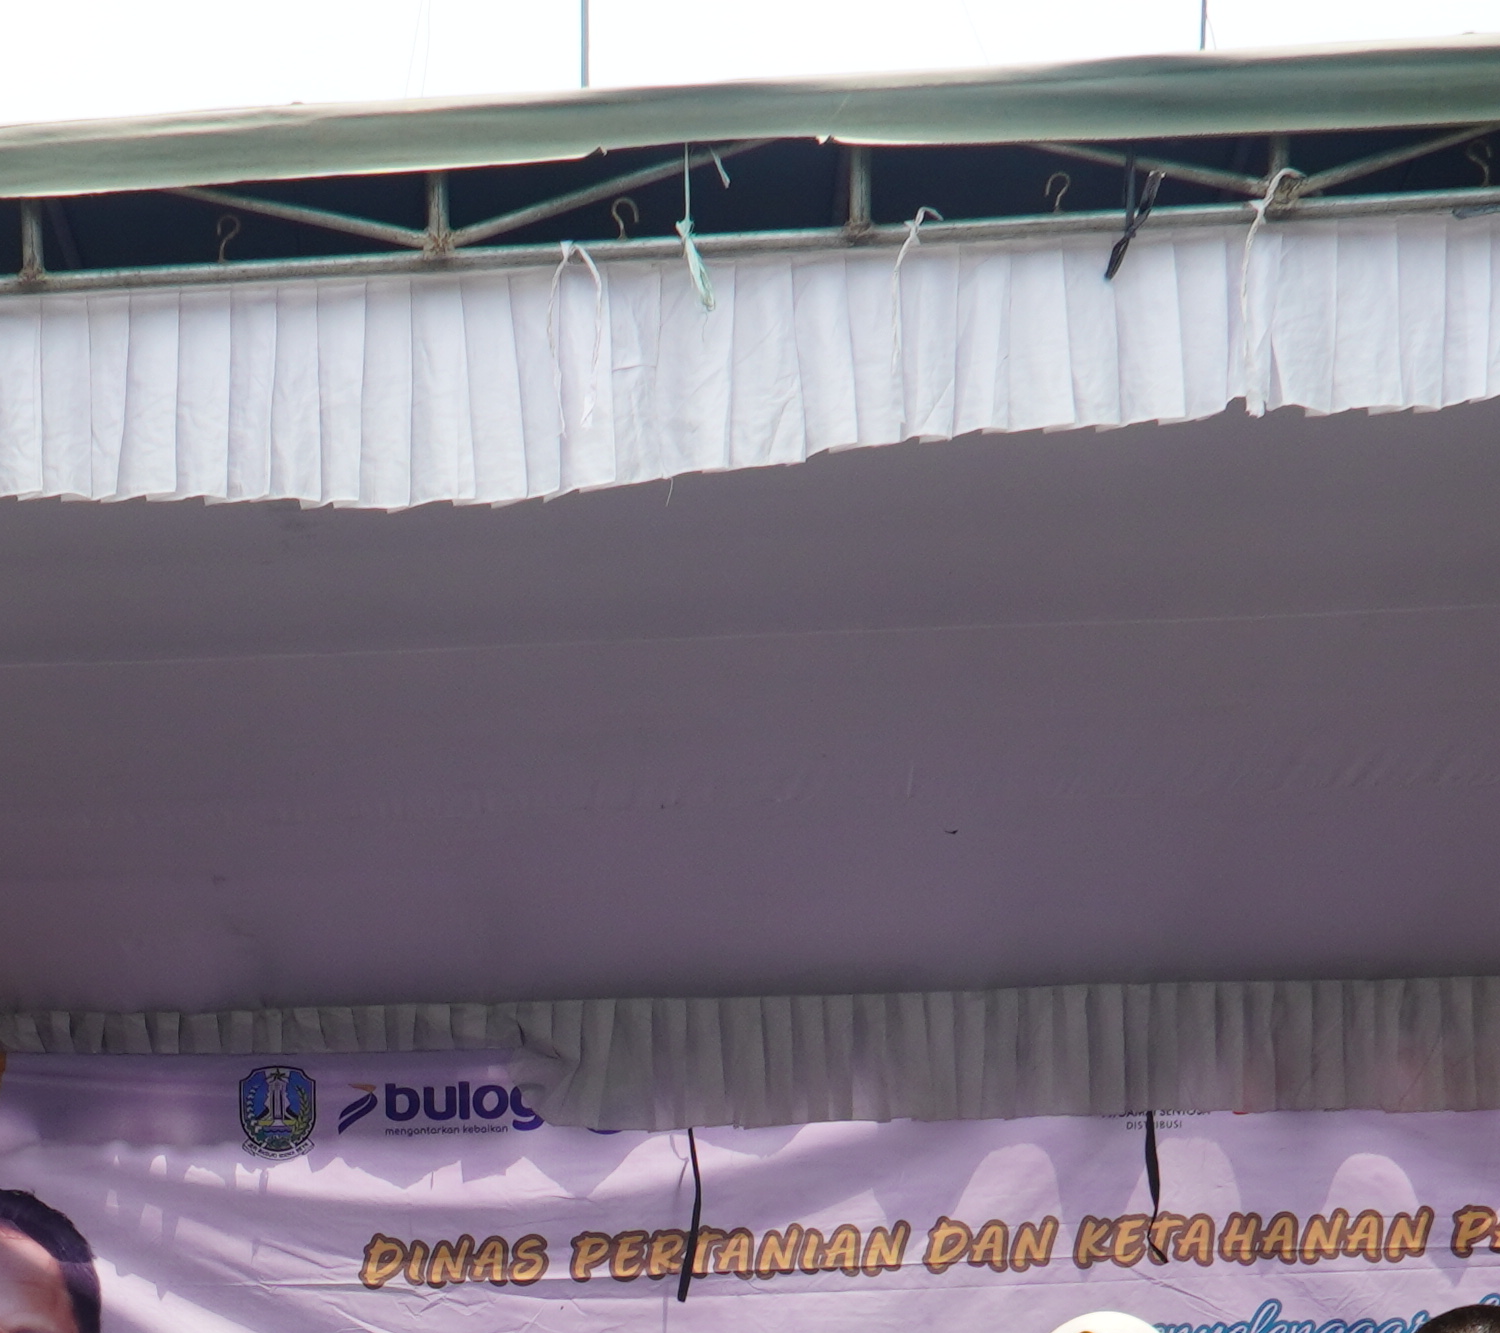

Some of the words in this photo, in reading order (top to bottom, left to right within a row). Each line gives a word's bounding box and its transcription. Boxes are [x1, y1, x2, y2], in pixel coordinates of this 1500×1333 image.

[384, 1080, 545, 1131] bulog
[463, 1124, 509, 1135] kebaikan
[1126, 1120, 1183, 1131] DISTIBUSI
[361, 1231, 550, 1291] DINAS
[569, 1219, 911, 1284] PERTANIAN
[923, 1213, 1059, 1274] DAN
[1074, 1204, 1434, 1270] KETAHANAN
